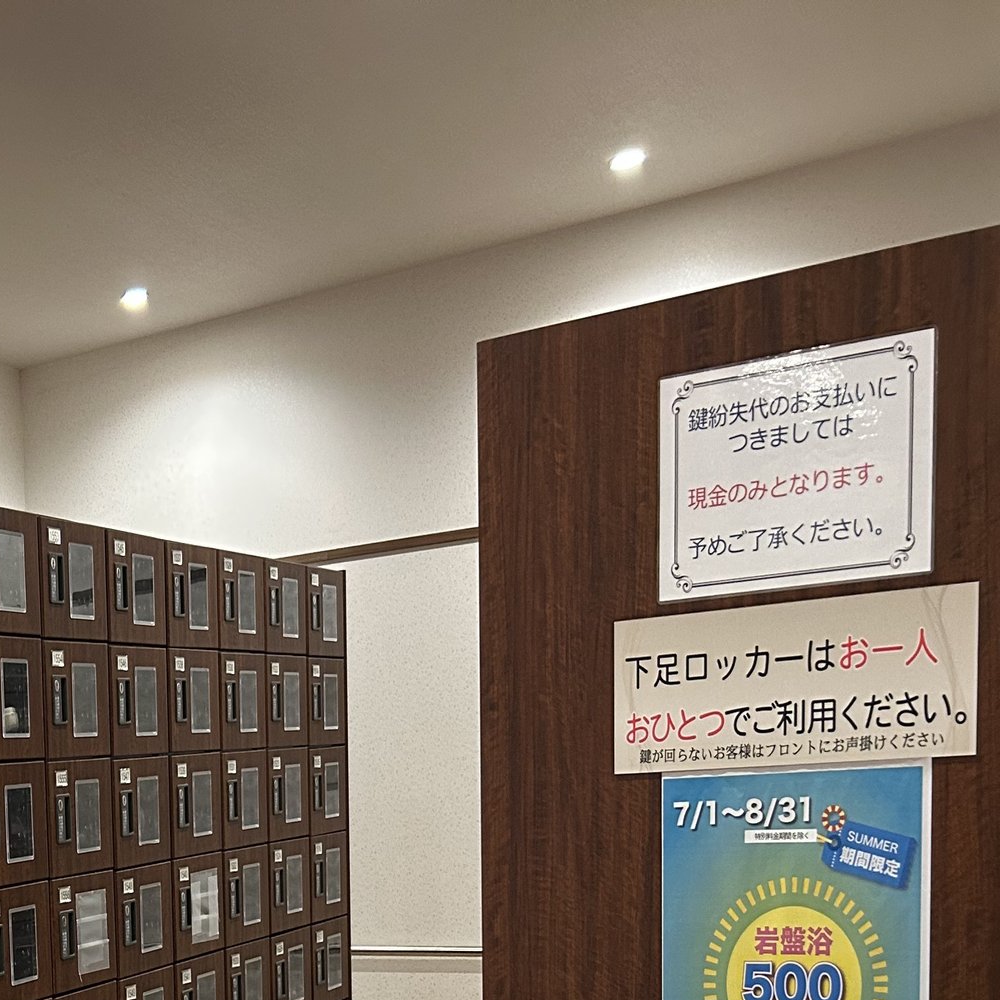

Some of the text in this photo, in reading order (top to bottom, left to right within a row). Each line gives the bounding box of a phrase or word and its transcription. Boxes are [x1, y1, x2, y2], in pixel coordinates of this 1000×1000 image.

[688, 376, 898, 432] 鍵紛失代のお支払いに
[729, 413, 855, 453] つきましては
[688, 462, 885, 511] 現金のみとなります。
[688, 517, 884, 560] 予めご了承ください。
[625, 627, 939, 690] 下足ロッカーはお一人
[625, 690, 968, 746] おひとつでご利用ください。
[639, 732, 945, 765] 鍵が回らないお客様はフロントにお声掛けください
[839, 845, 901, 878] 期間限定
[847, 830, 899, 854] SUMMER
[754, 926, 834, 956] 岩盤浴
